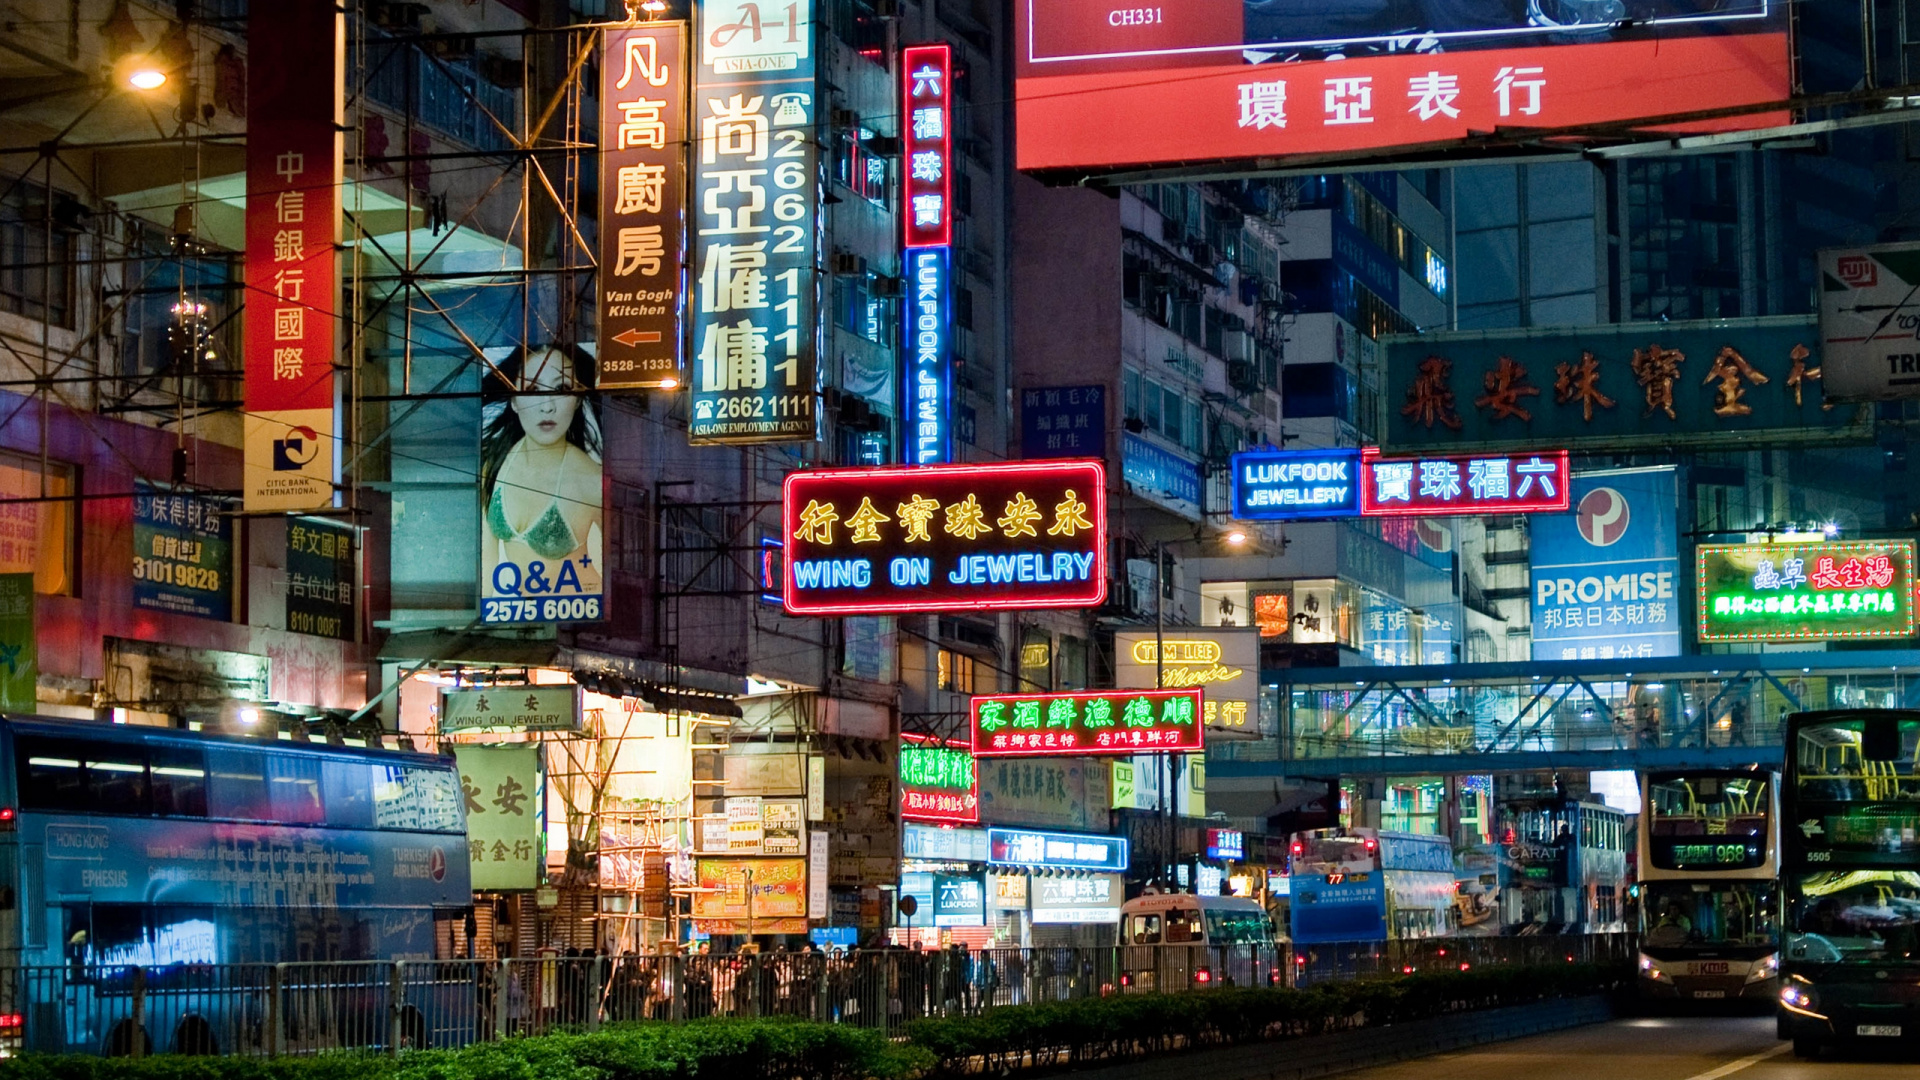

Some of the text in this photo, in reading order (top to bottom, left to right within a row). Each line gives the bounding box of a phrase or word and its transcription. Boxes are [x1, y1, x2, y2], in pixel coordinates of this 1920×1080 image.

[709, 2, 802, 48] A-1
[1108, 8, 1163, 27] CH331
[723, 56, 786, 71] ASIA-ONE
[1236, 66, 1546, 131] 環亞表行
[912, 66, 942, 226] 六福珠寶
[614, 36, 669, 277] 凡高廚房
[698, 94, 771, 392] 尚亞僱傭
[273, 150, 305, 381] 中信銀行國際
[606, 289, 673, 304] Van Gogh
[609, 305, 665, 317] Kitchen
[603, 359, 672, 371] 3528-1333
[918, 254, 938, 467] LUKFOOK JEWELL
[716, 395, 810, 418] 2662 1111
[695, 420, 810, 436] ASIA-ONE EMPLOYMENT AGENCY
[1047, 432, 1080, 448] 招生
[1246, 462, 1347, 484] LUKFOOK
[1374, 457, 1556, 501] 六福珠寶
[257, 487, 319, 496] INTERNATIONAL
[1247, 487, 1347, 506] JEWELLERY
[152, 496, 219, 533] 保得財務
[793, 489, 1093, 545] 永安珠寶金行
[291, 525, 349, 560] 舒文國際
[133, 556, 218, 591] 3101 9828
[793, 552, 1094, 589] WING ON JEWELRY
[1812, 556, 1895, 590] 長生湯
[1537, 572, 1673, 606] PROMISE
[486, 599, 599, 622] 2575 6006
[1543, 603, 1667, 629] 邦民日本財務
[291, 611, 314, 631] 8101
[1184, 645, 1213, 660] LEE
[1156, 664, 1242, 690] Music
[455, 714, 560, 726] WING ON JEWELRY
[979, 696, 1193, 732] 順德漁鮮酒家
[56, 833, 109, 849] HONG KONG
[393, 848, 429, 862] TURKISH
[1509, 846, 1560, 859] CARAT
[1716, 845, 1745, 863] 968
[1807, 852, 1831, 862] 5505
[82, 870, 128, 887] EPHESUS
[393, 864, 429, 878] AIRLINES
[1329, 874, 1343, 885] 77
[941, 881, 978, 900] 六福
[941, 900, 978, 908] LUKFOOK
[1700, 963, 1729, 974] KMB
